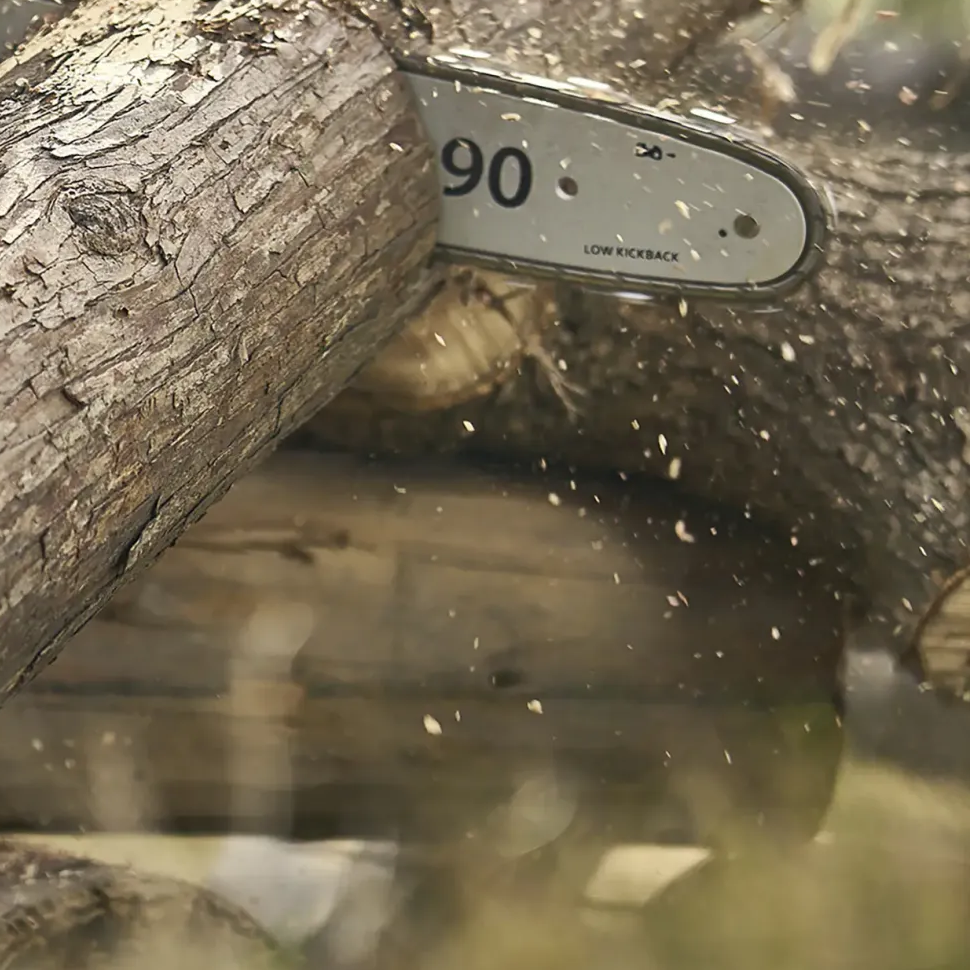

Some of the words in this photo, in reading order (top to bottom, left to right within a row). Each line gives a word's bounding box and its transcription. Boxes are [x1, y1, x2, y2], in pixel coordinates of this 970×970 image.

[441, 137, 533, 209] 90
[583, 244, 614, 257] LOW
[616, 247, 679, 262] KICKBACK
